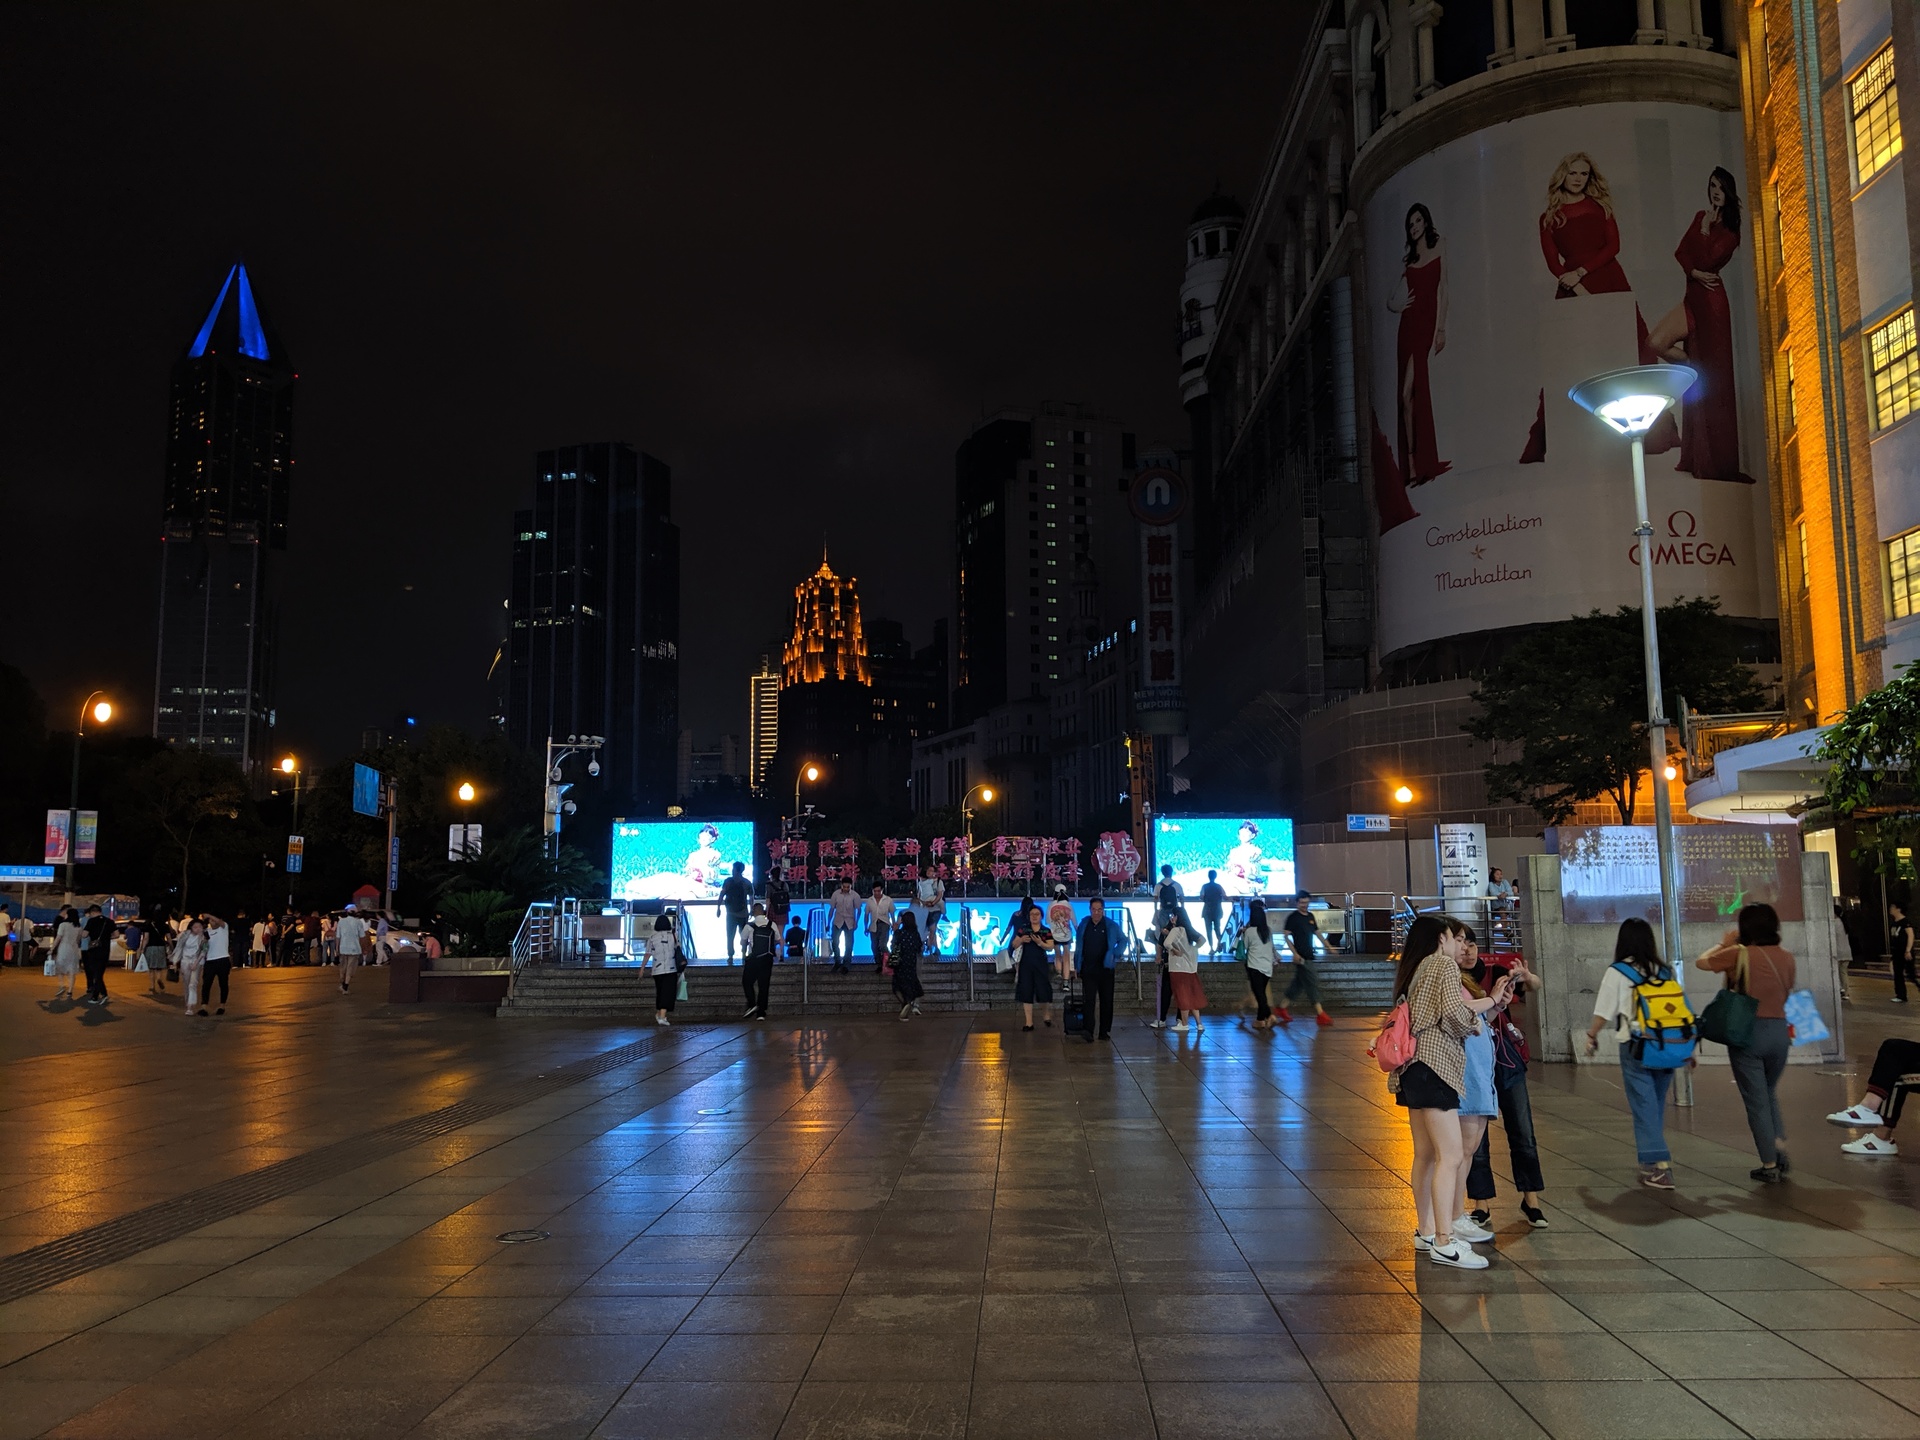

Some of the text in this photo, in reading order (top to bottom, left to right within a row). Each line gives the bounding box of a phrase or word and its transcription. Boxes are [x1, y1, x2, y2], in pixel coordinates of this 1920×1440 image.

[1425, 513, 1543, 547] Constellation
[1628, 542, 1736, 566] OMEGA
[1434, 563, 1532, 591] Manhattan
[1147, 535, 1174, 682] 新世界城
[1133, 688, 1186, 700] NEW WORL
